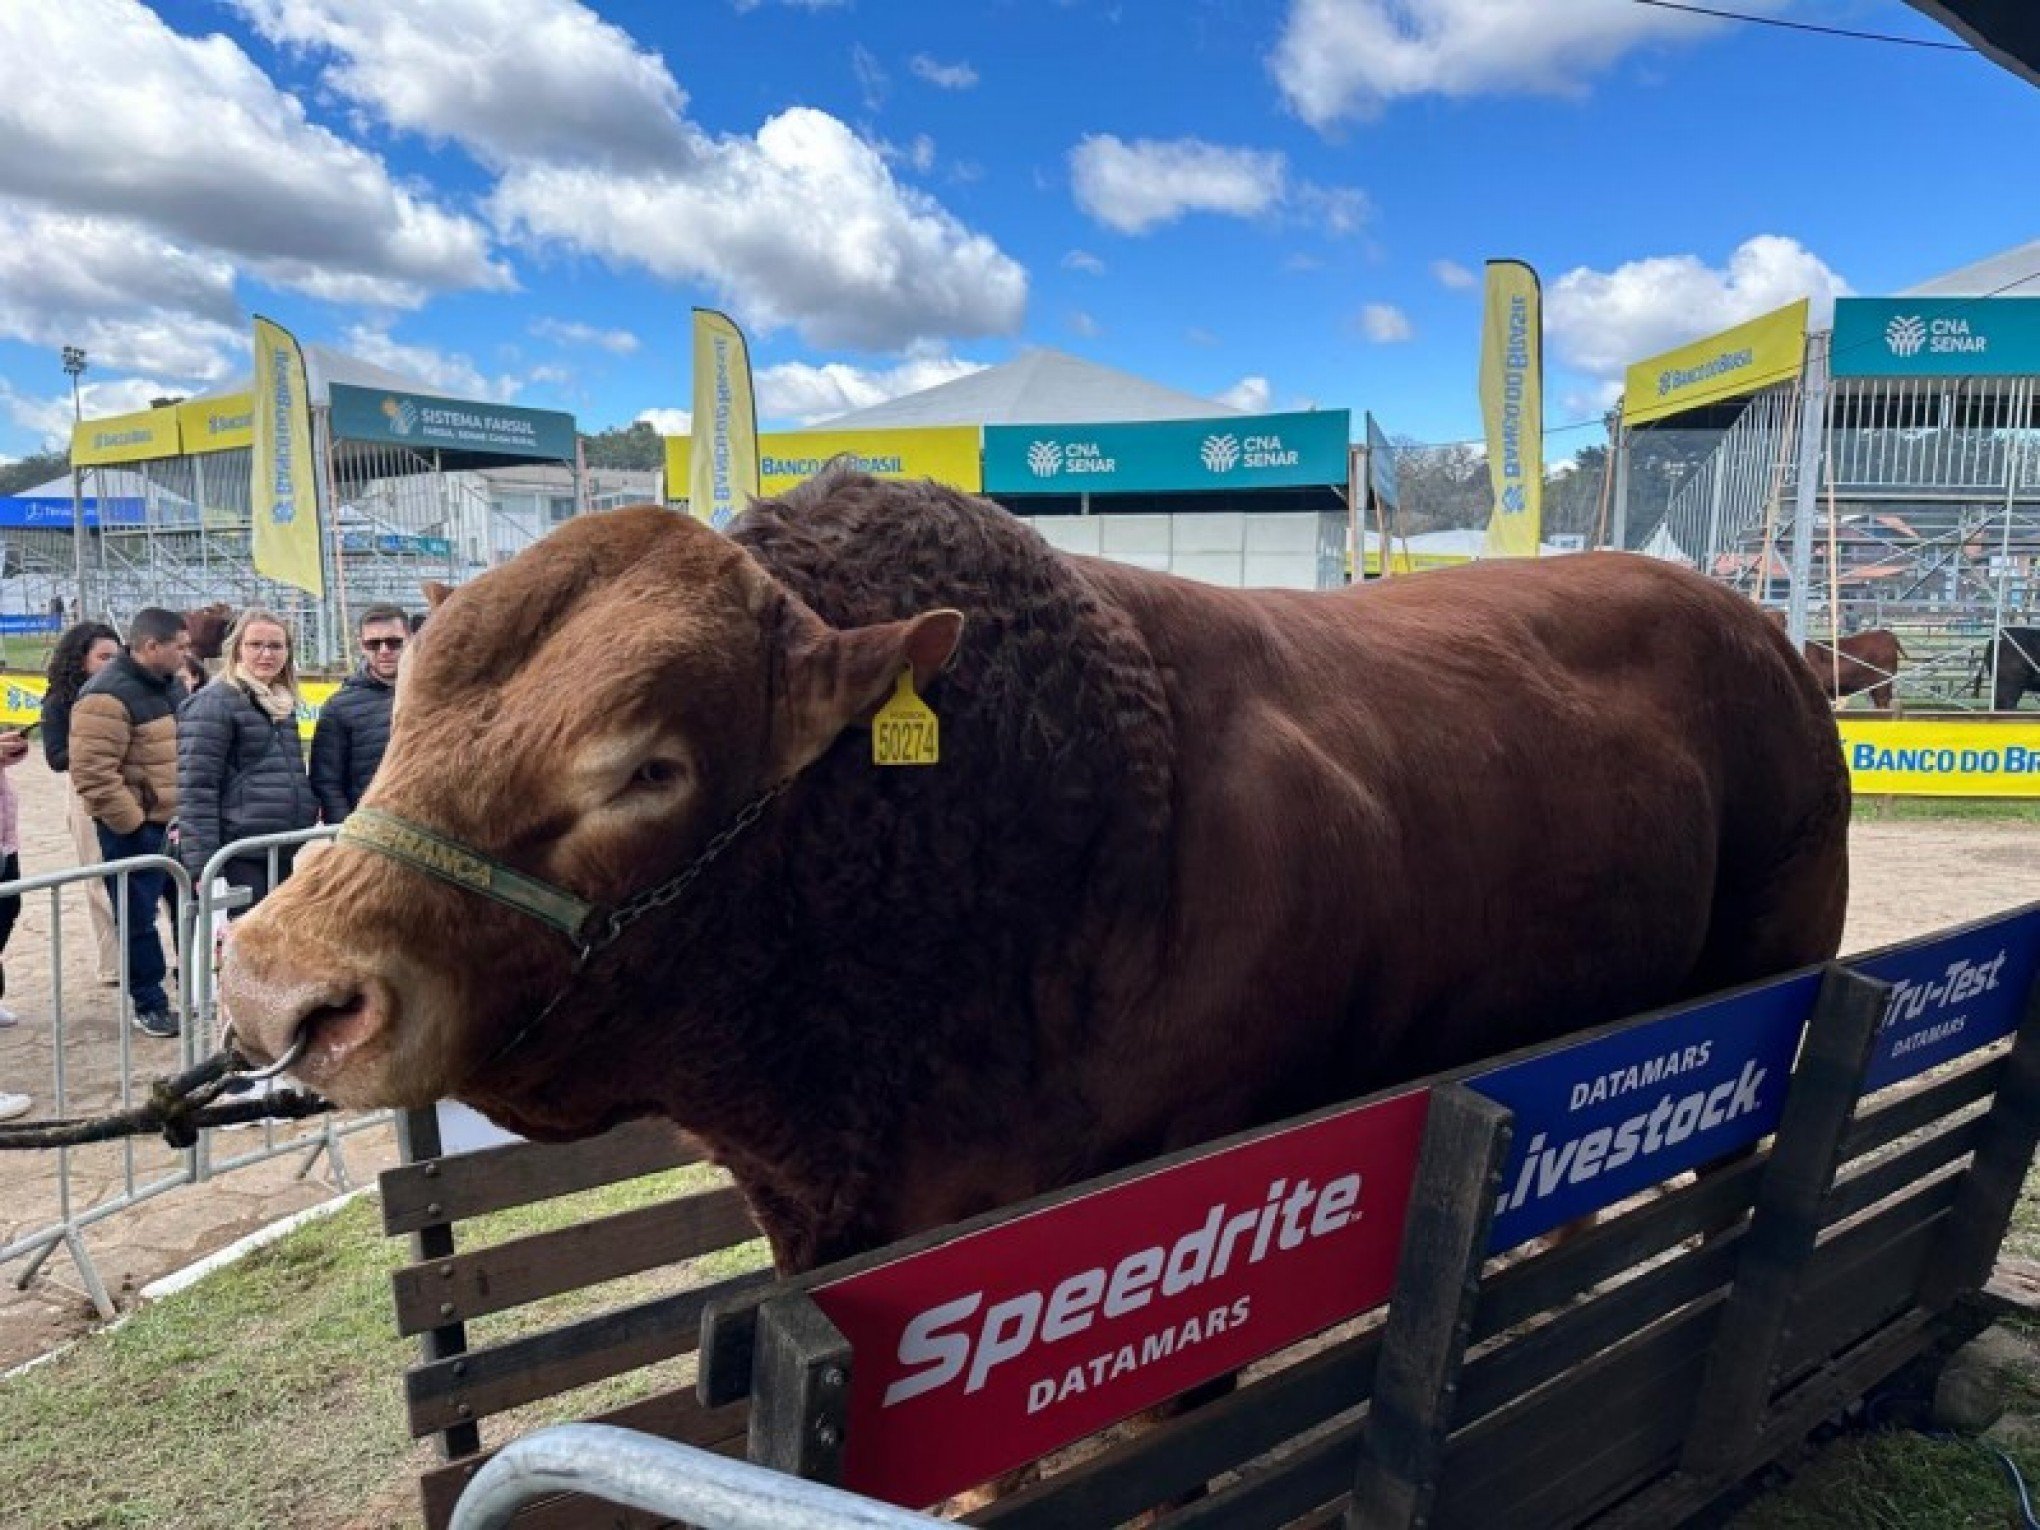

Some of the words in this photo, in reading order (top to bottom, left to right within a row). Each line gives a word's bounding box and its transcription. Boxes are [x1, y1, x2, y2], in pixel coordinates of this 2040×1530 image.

[1929, 319, 1969, 334] CNA
[1929, 336, 1987, 352] SENAR
[420, 408, 483, 428] SISTEMA
[484, 416, 536, 435] FARSUL
[1065, 443, 1100, 458] CNA
[1244, 435, 1283, 451] CNA
[1065, 459, 1116, 473] SENAR
[1244, 451, 1299, 468] SENAR
[879, 721, 935, 762] 50274
[1853, 744, 1954, 772] BANCO
[1960, 749, 2000, 773] DO
[1891, 1014, 1966, 1059] DATAMARS
[1568, 1040, 1713, 1112] DATAMARS
[1494, 1060, 1767, 1216] ivestock
[882, 1172, 1361, 1407] Speedrite
[1026, 1295, 1251, 1415] DATAMARS
